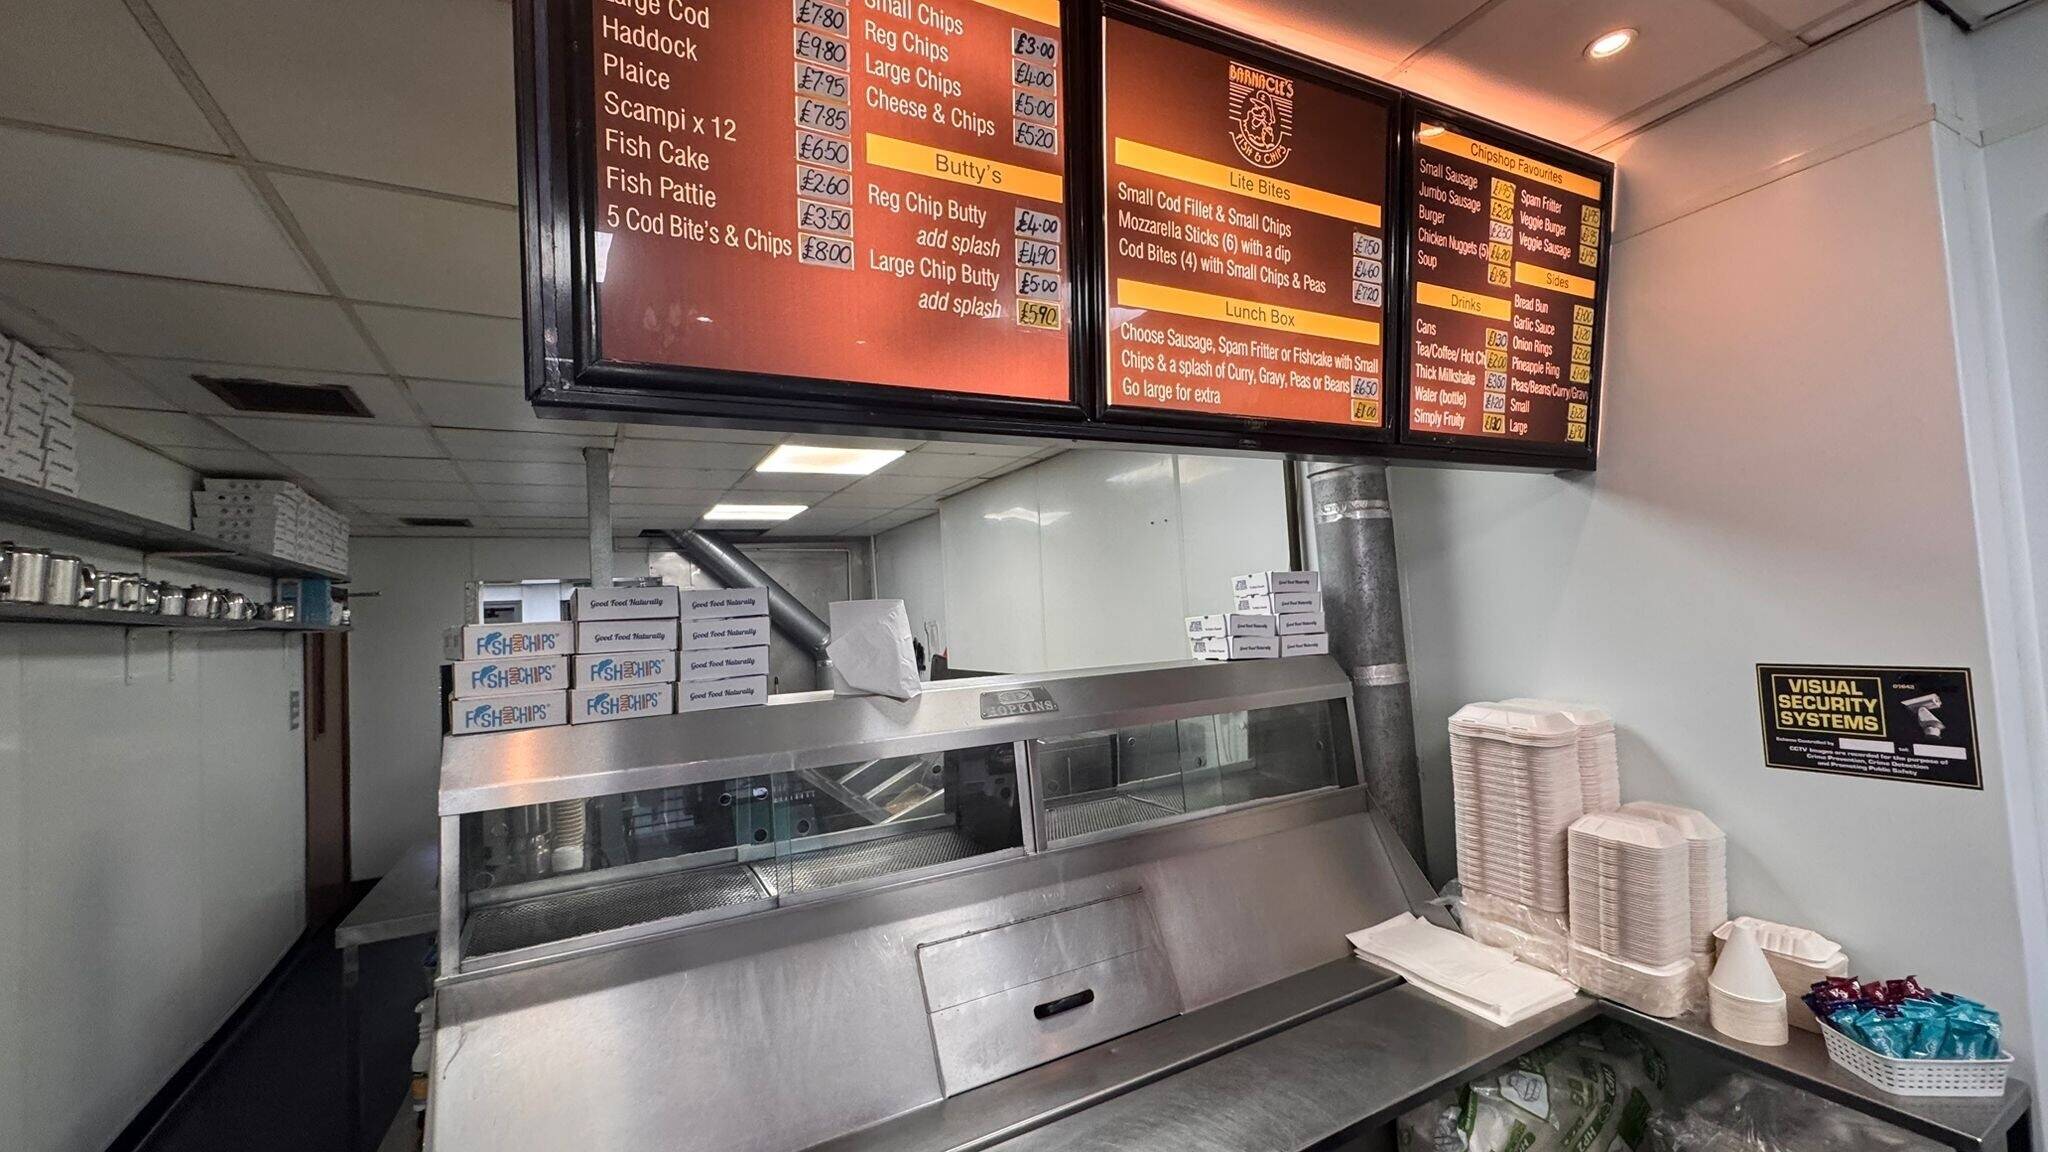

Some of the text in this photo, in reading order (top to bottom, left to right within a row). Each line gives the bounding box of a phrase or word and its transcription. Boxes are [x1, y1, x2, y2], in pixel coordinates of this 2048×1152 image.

[668, 0, 709, 29] Cod
[918, 3, 964, 35] Chips
[602, 15, 698, 61] Haddock
[796, 31, 846, 62] £9.80
[865, 19, 949, 62] Reg Chips
[1015, 32, 1055, 59] £3.00
[603, 53, 670, 90] Plaice
[798, 66, 845, 97] £7.95
[865, 52, 962, 97] Large Chips
[604, 91, 737, 142] Scampi x 12
[800, 100, 846, 130] £7.85
[866, 85, 995, 136] Cheese & Chips
[605, 128, 710, 171] Fish Cake
[1471, 142, 1563, 184] Chipshop Favourites
[935, 153, 1002, 185] Butty's
[1420, 158, 1478, 191] Small Sausage
[606, 166, 717, 208] Fish Pattie
[1230, 171, 1291, 200] Lite Bites
[1419, 181, 1481, 214] Jumbo Sausage
[1521, 189, 1541, 208] Spam
[868, 184, 987, 229] Reg Chip Butty
[1118, 182, 1292, 238] Small Cod Fillet & Small Chips
[1419, 204, 1446, 226] Burger
[607, 205, 793, 258] 5 Cod Bite's & Chips
[1118, 209, 1291, 265] Mozzarella Sticks (6) with a dip
[1520, 210, 1567, 238] Veggie Burger
[917, 228, 1001, 259] add splash
[1418, 227, 1447, 248] Chicken
[1449, 235, 1478, 256] Nuggets
[1519, 231, 1572, 260] Veggie Sausage
[869, 249, 1000, 292] Large Chip Butty
[1119, 238, 1326, 294] Cod Bites (4) with Small Chips & Peas
[1418, 249, 1437, 271] Soup
[1546, 272, 1569, 289] Sides
[918, 291, 1002, 320] add splash
[1226, 301, 1296, 327] Lunch Box
[1451, 294, 1482, 313] Drinks
[1514, 294, 1548, 313] Bread Bun
[1416, 318, 1437, 336] Cans
[1513, 314, 1555, 336] Garlic Sauce
[1121, 322, 1378, 374] Choose Sausage, Spam Fritter or Fishcake with Small
[1461, 348, 1474, 364] Hot
[1513, 335, 1553, 357] Onion Rings
[1121, 350, 1350, 394] Chips & a splash of Curry, Gravy, Peas or Beans
[1416, 363, 1476, 386] Thick Milkshake
[1511, 356, 1560, 379] Pineapple Ring
[1122, 377, 1221, 404] Go large for extra
[1415, 385, 1438, 402] Water
[1414, 408, 1466, 429] Simply Fruity
[1510, 398, 1530, 413] Small
[1510, 419, 1528, 436] Large
[1788, 678, 1863, 696] VISUAL
[1778, 693, 1878, 714] SECURITY
[1780, 711, 1879, 732] SYSTEMS
